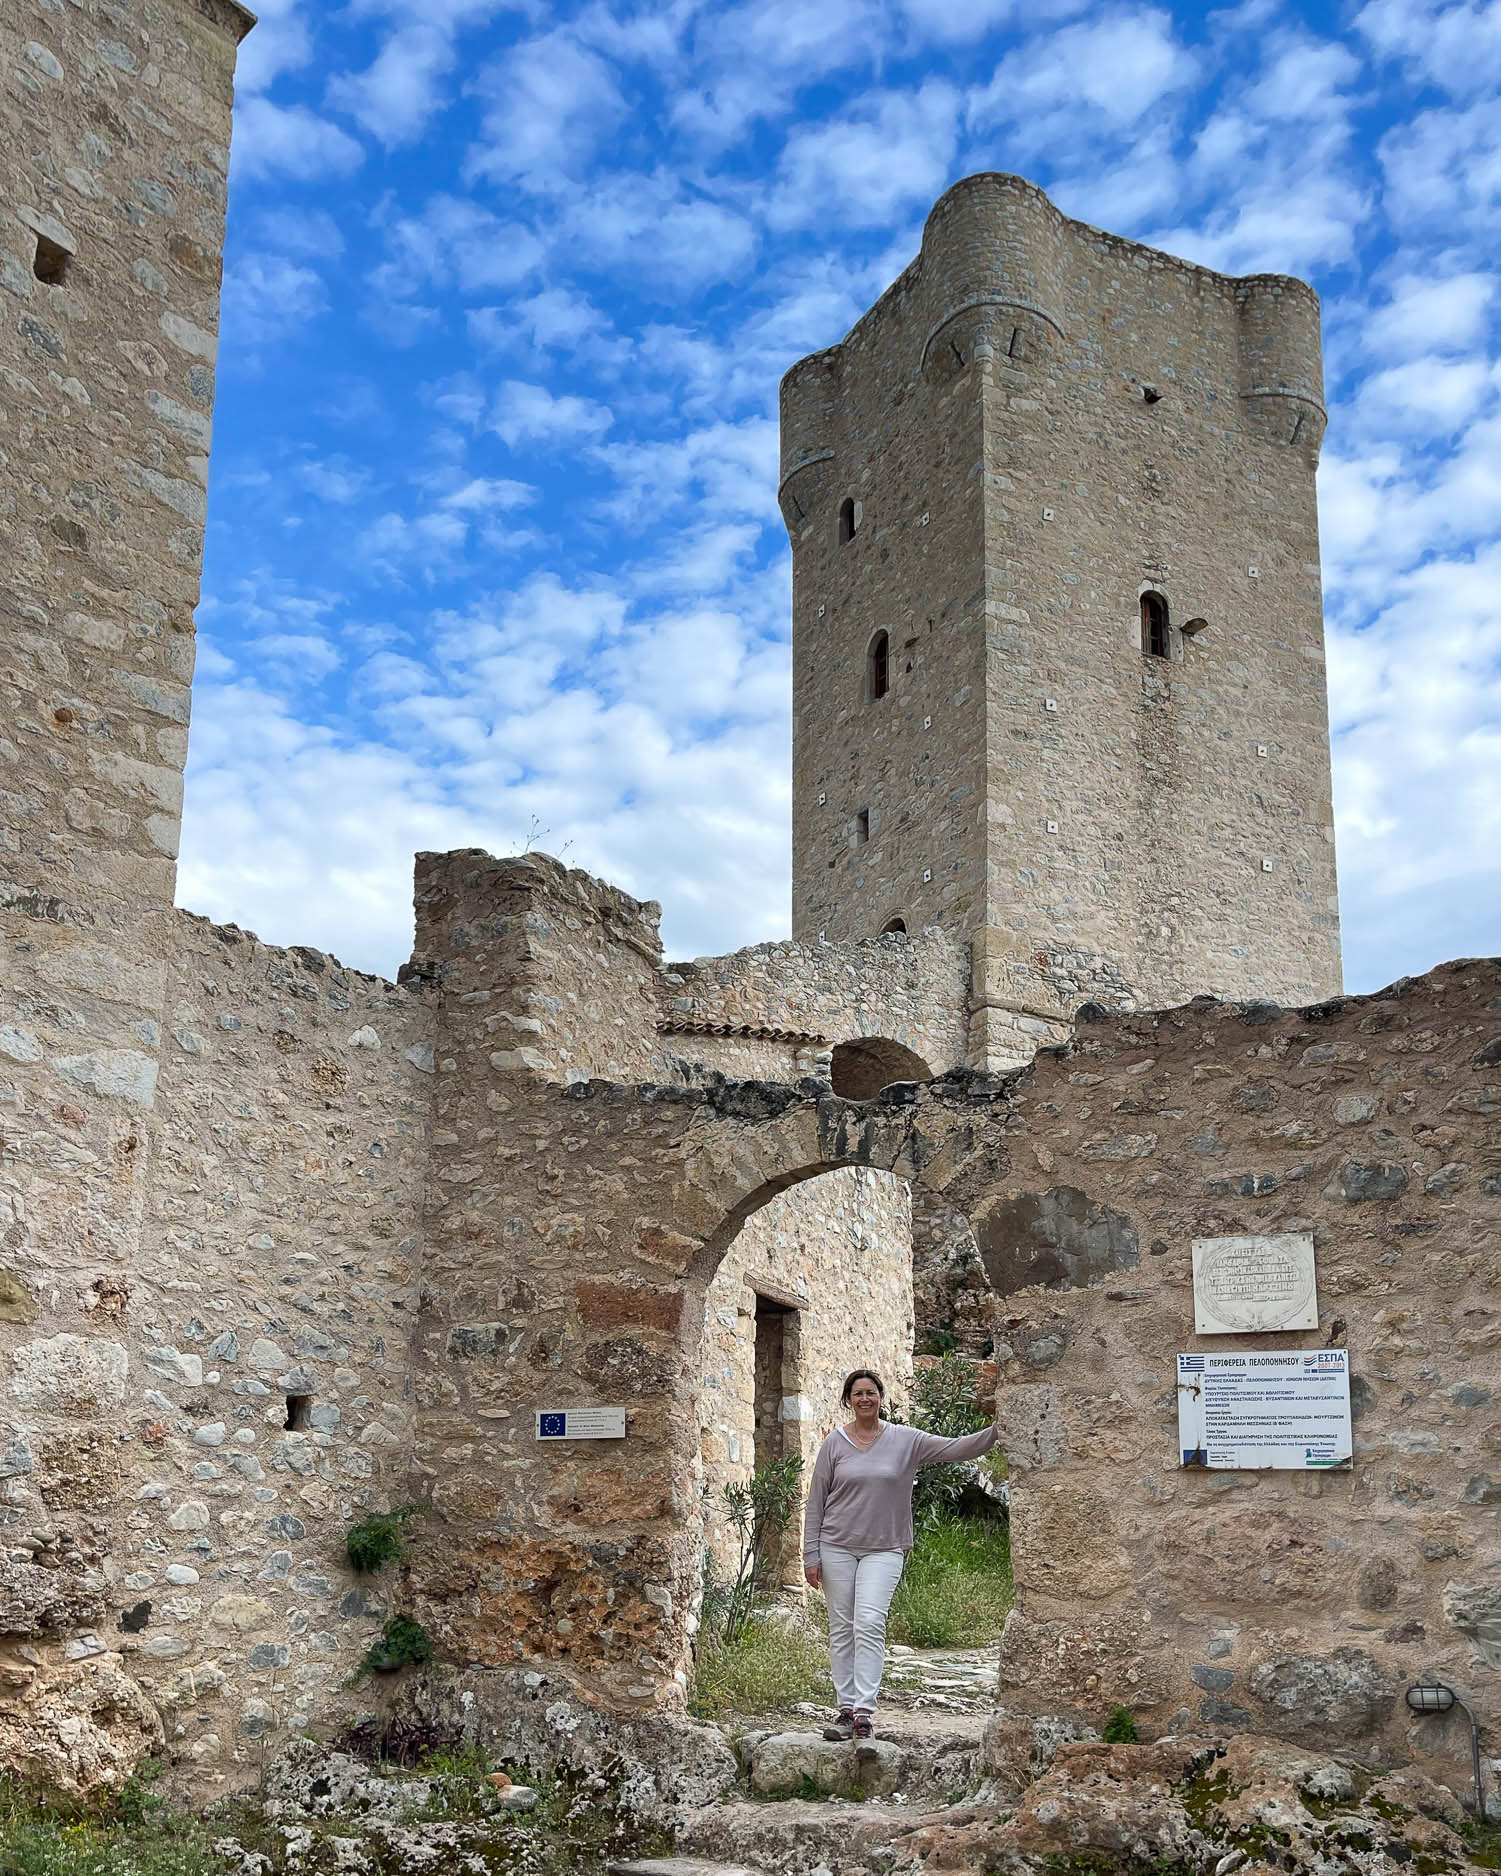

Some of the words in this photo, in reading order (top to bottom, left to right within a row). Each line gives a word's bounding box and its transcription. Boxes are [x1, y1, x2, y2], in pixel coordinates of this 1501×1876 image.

[1209, 1359, 1247, 1367] ΠΕΡΙΦΕΡΕΙΑ
[1249, 1357, 1299, 1366] ΠΕΛΟΠΟΝΝΗΣΟΥ
[1317, 1353, 1345, 1362] ΕΣΠΑ
